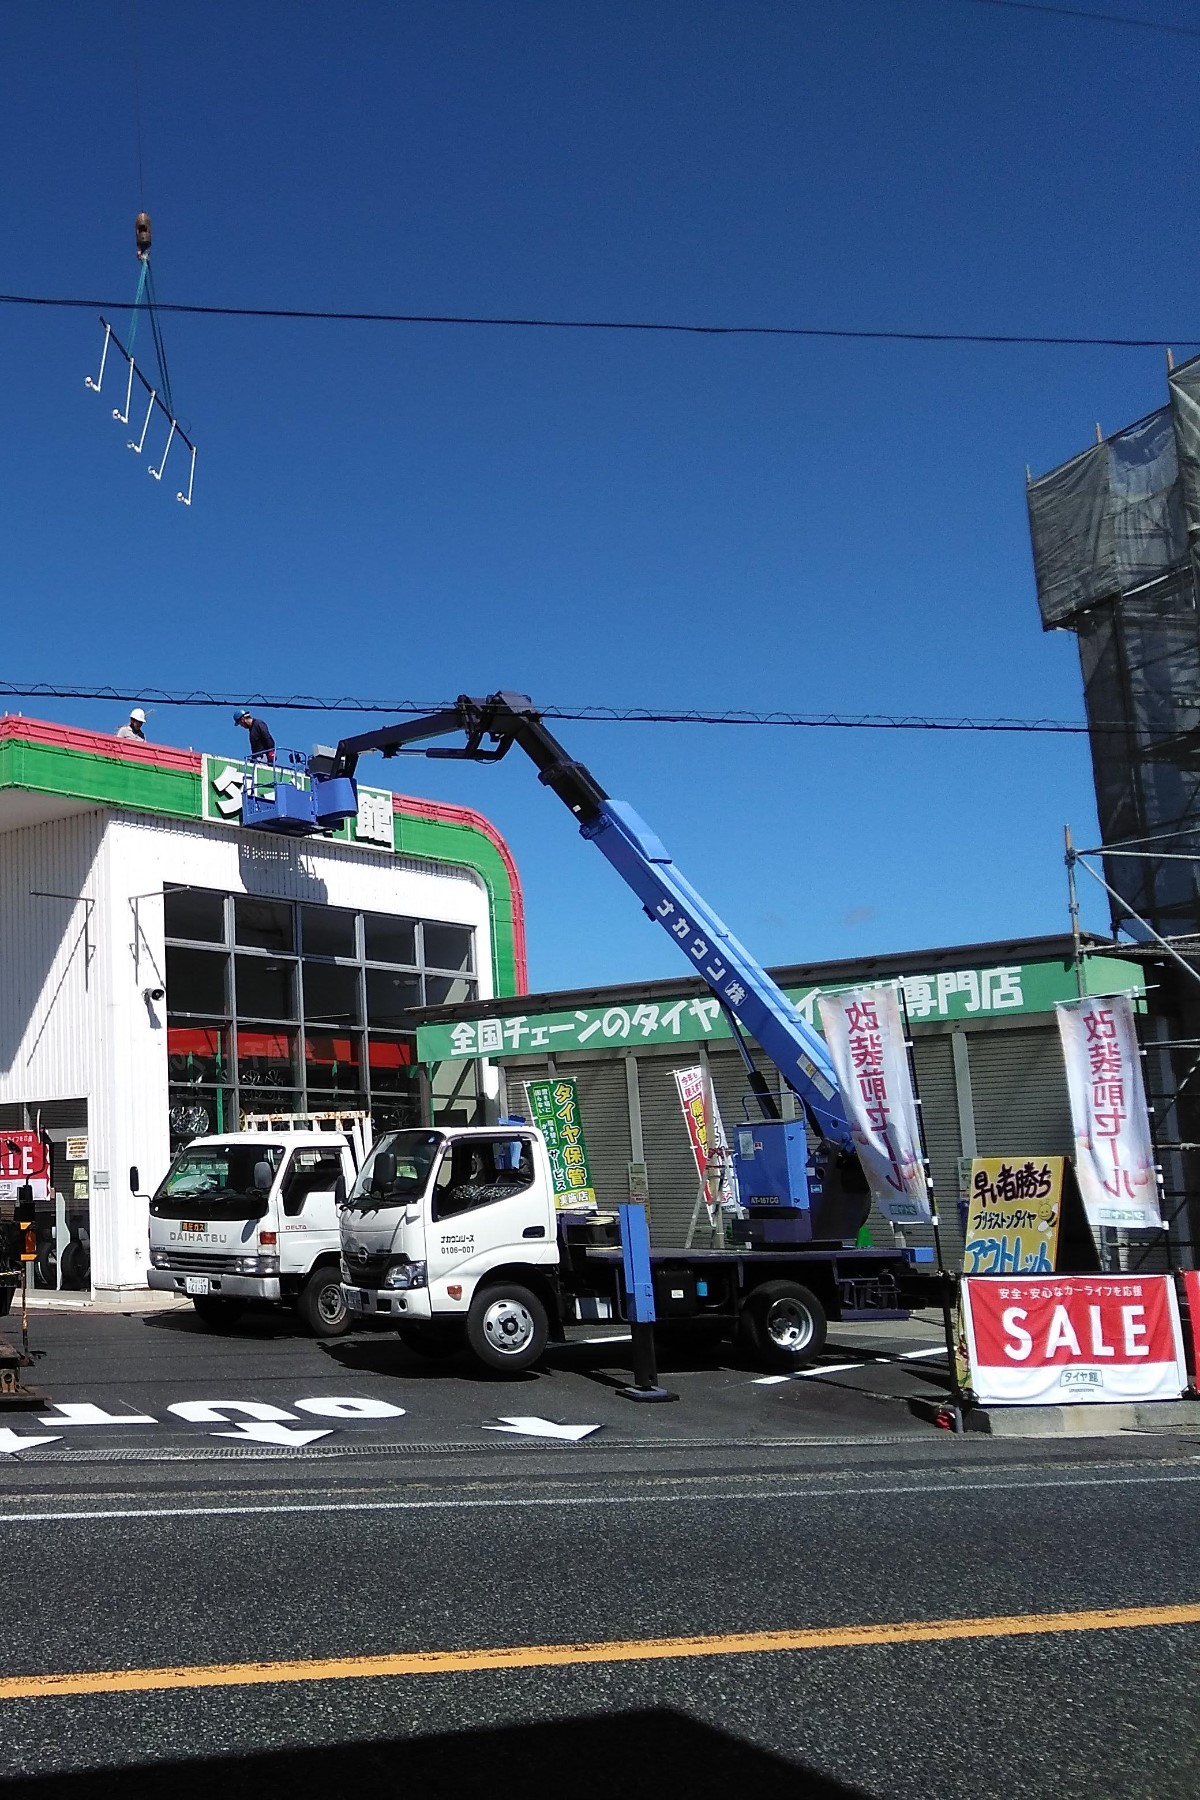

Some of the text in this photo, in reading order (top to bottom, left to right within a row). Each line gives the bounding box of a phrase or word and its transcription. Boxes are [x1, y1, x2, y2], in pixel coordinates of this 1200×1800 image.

[554, 1083, 588, 1188] タイヤ保管
[549, 1149, 566, 1192] サービス
[973, 1161, 1052, 1208] 早い者勝ち
[170, 1231, 227, 1244] DAIHATSU
[998, 1285, 1143, 1300] 安全・安心なカーライフを応援
[1002, 1304, 1150, 1361] SALE
[1064, 1371, 1099, 1383] タイヤ館
